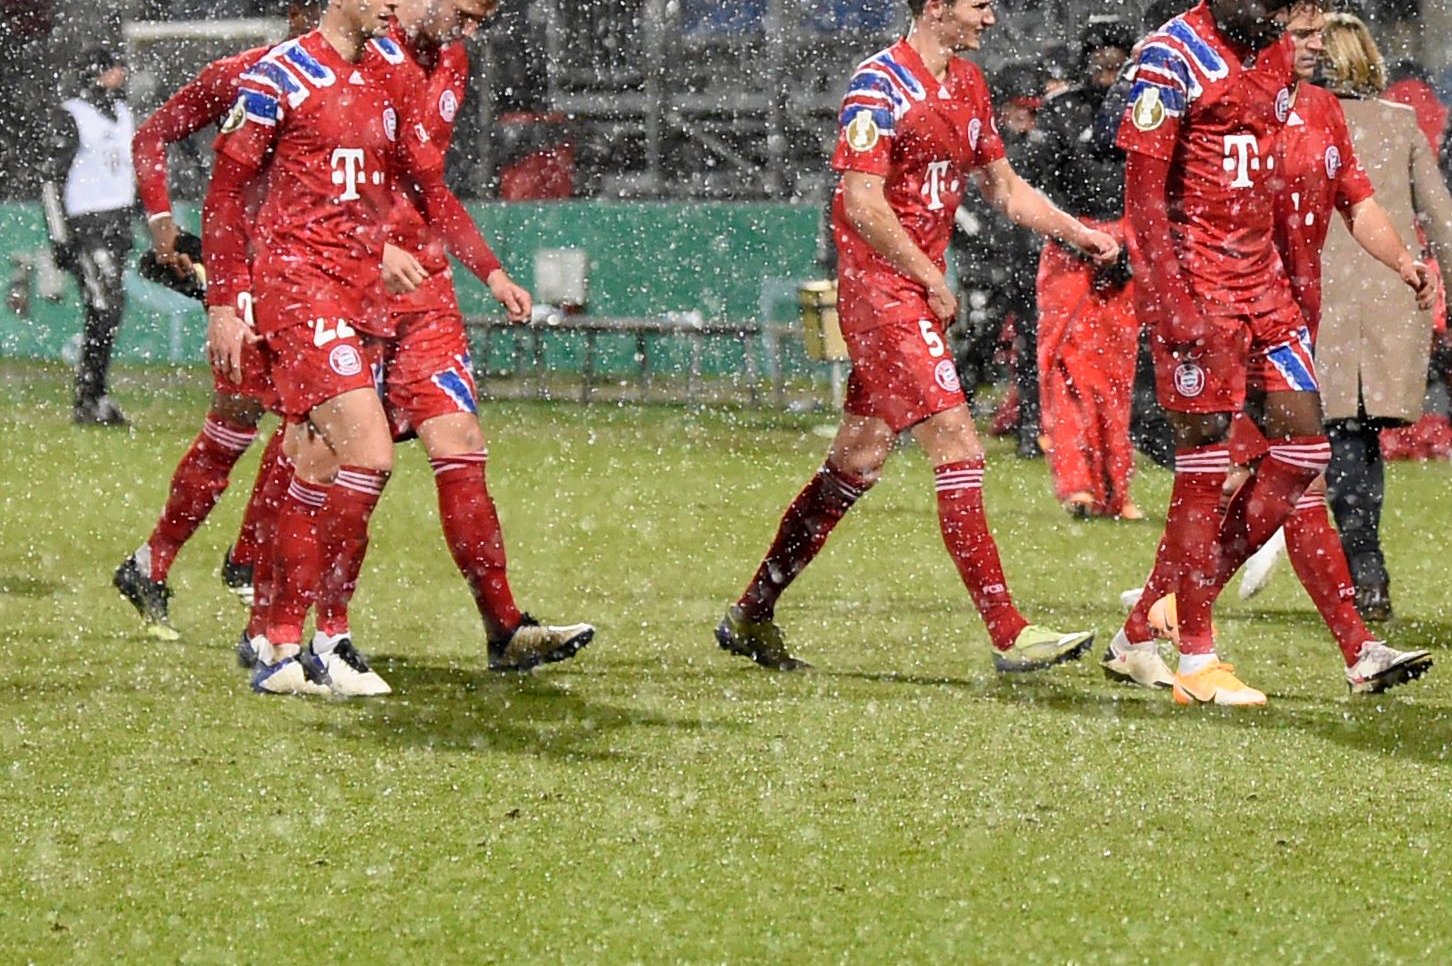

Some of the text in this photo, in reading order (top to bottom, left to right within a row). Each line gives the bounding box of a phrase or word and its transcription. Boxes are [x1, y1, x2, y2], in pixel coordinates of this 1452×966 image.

[331, 148, 365, 201] T
[921, 160, 951, 210] T
[1222, 134, 1260, 188] T
[918, 320, 945, 357] 5
